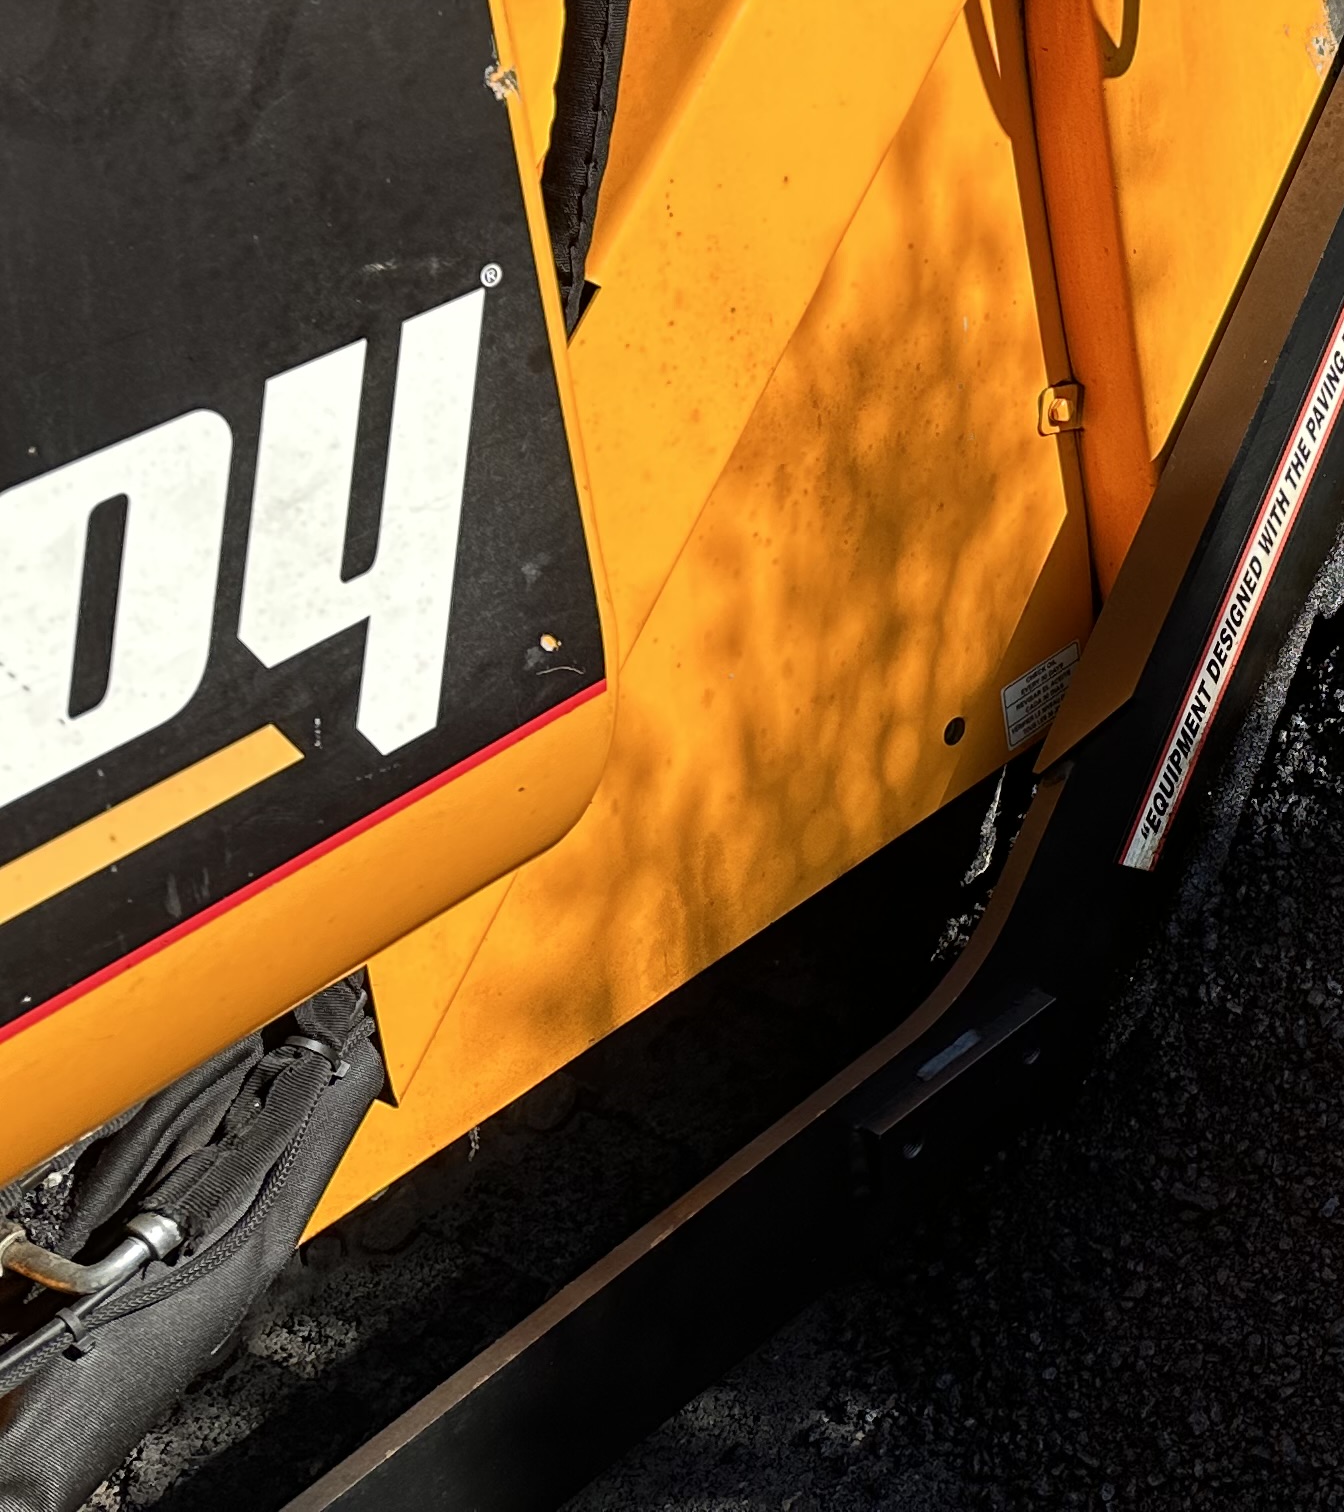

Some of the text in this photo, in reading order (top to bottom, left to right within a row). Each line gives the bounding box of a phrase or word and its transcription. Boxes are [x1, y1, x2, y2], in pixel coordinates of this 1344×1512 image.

[1206, 555, 1263, 685] DESIGNED
[1257, 487, 1290, 556] WITH
[1284, 437, 1311, 490] THE
